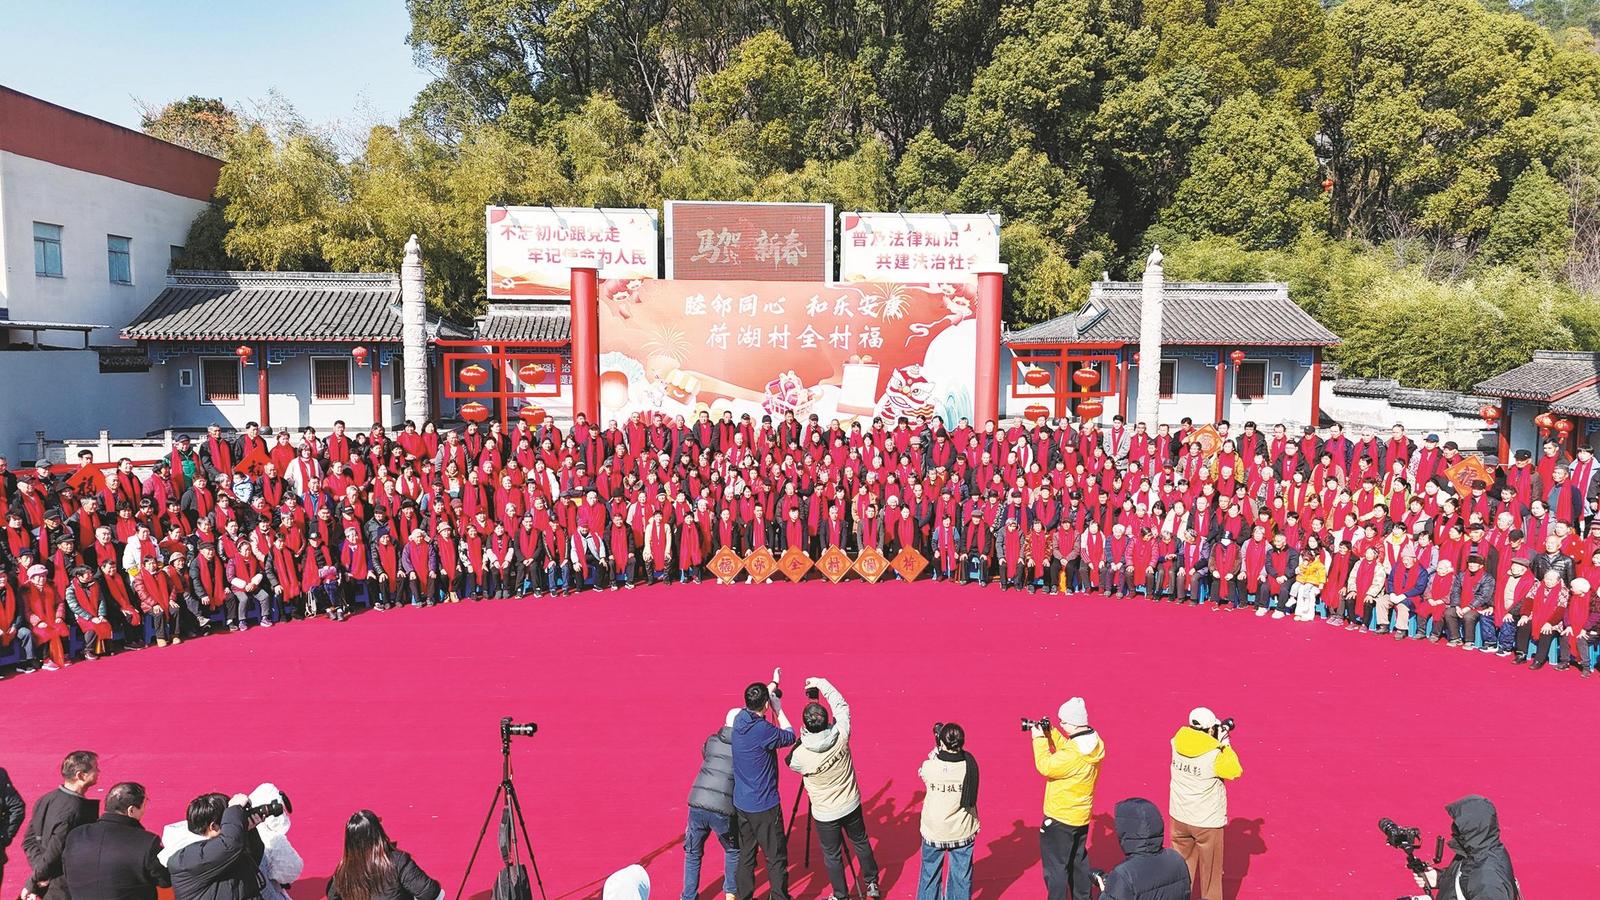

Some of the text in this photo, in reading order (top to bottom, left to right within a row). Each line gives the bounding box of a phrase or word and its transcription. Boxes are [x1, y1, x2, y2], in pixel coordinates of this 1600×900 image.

[500, 224, 621, 243] 不忘初心跟党走
[852, 230, 959, 248] 普及法律知识
[684, 293, 904, 319] 睦邻同心 和乐安康
[706, 324, 884, 351] 荷湖村全村福
[719, 557, 733, 572] 福
[788, 557, 803, 571] 全
